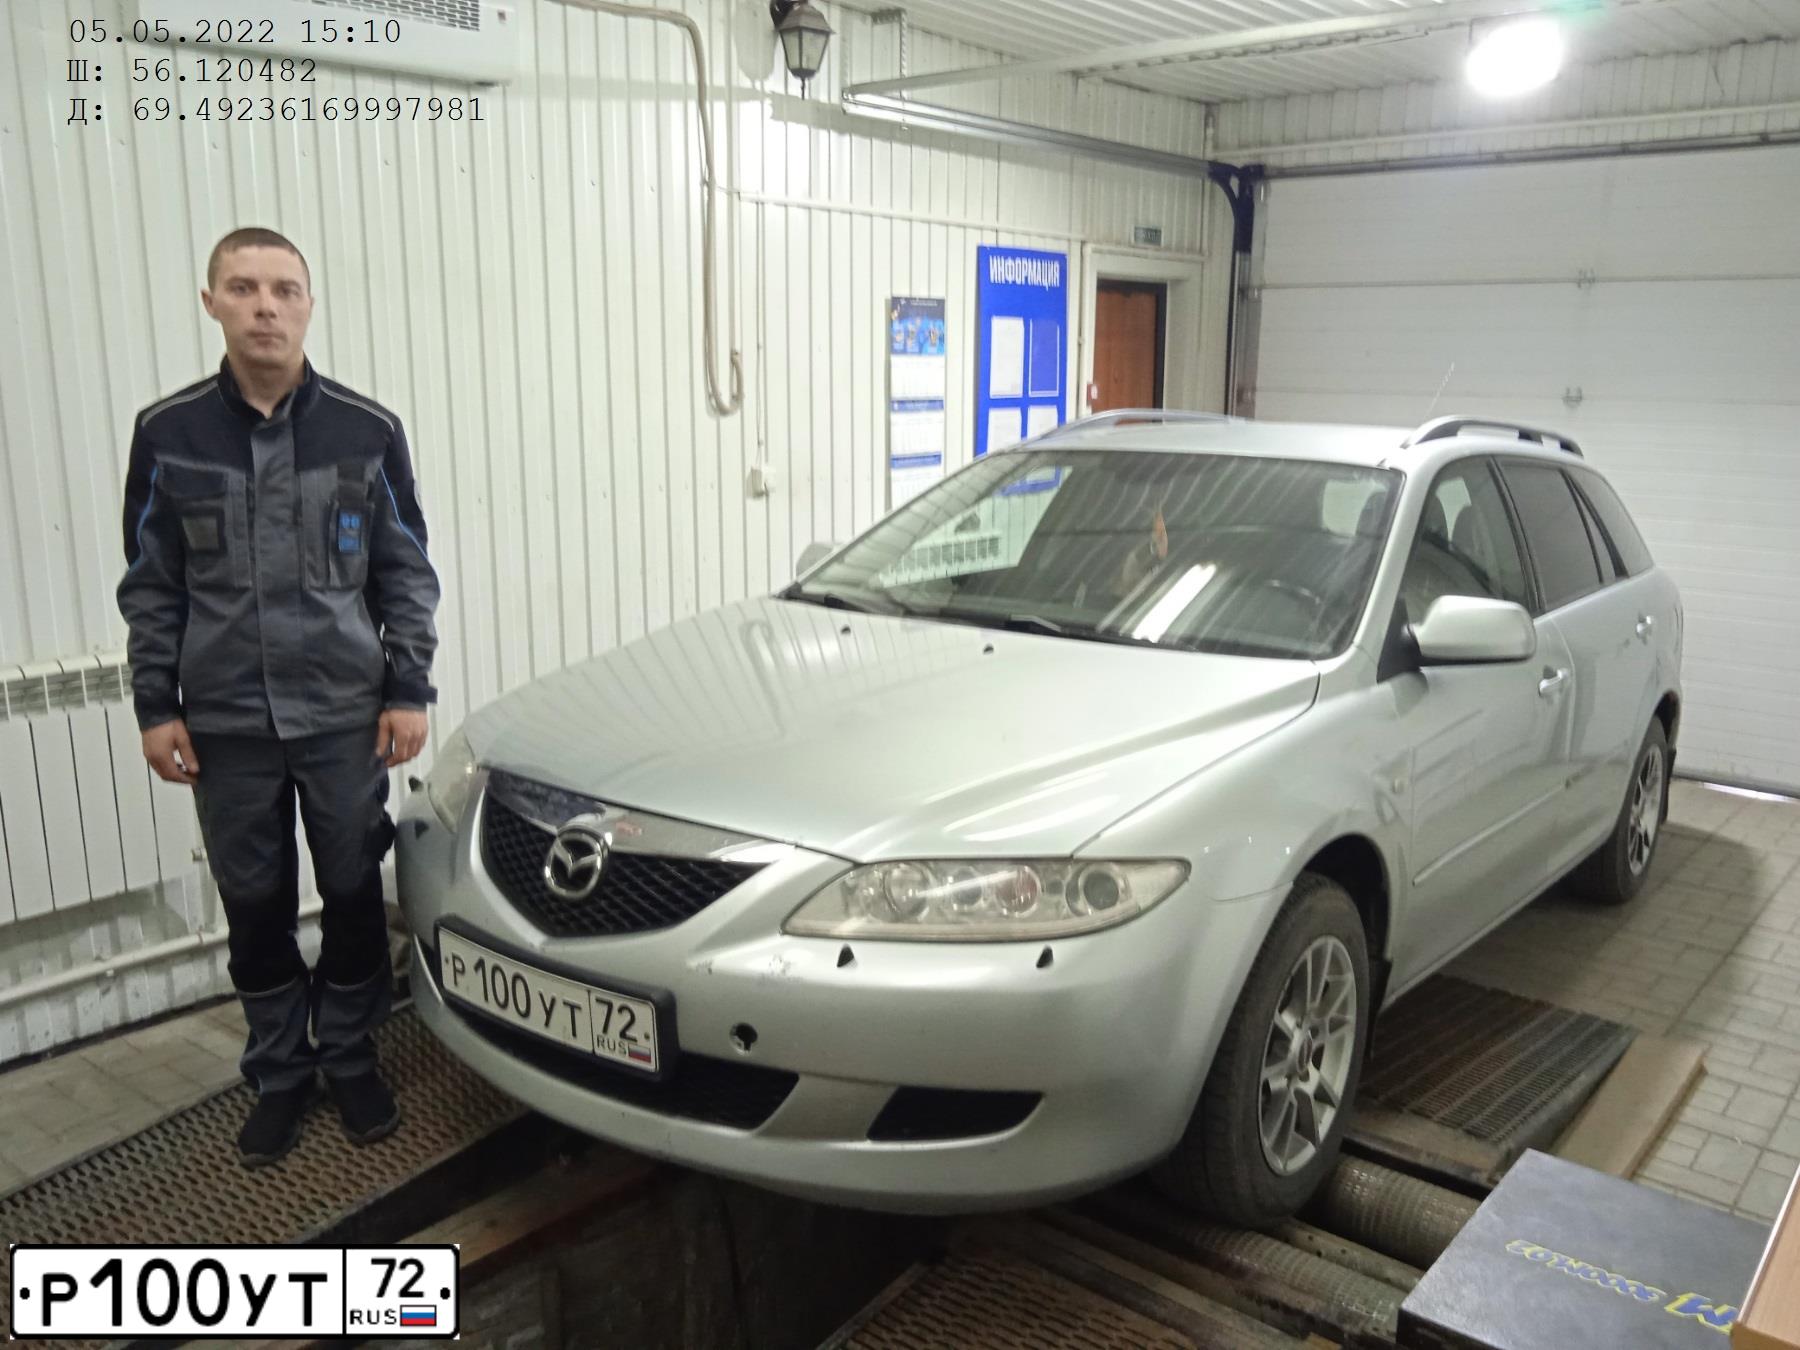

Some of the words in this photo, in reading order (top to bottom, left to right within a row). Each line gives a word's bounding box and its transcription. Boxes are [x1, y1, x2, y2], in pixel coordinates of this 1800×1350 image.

[989, 255, 1060, 290] ИНФОРМАЦИЯ
[595, 996, 638, 1043] 72
[596, 1034, 628, 1057] RUS
